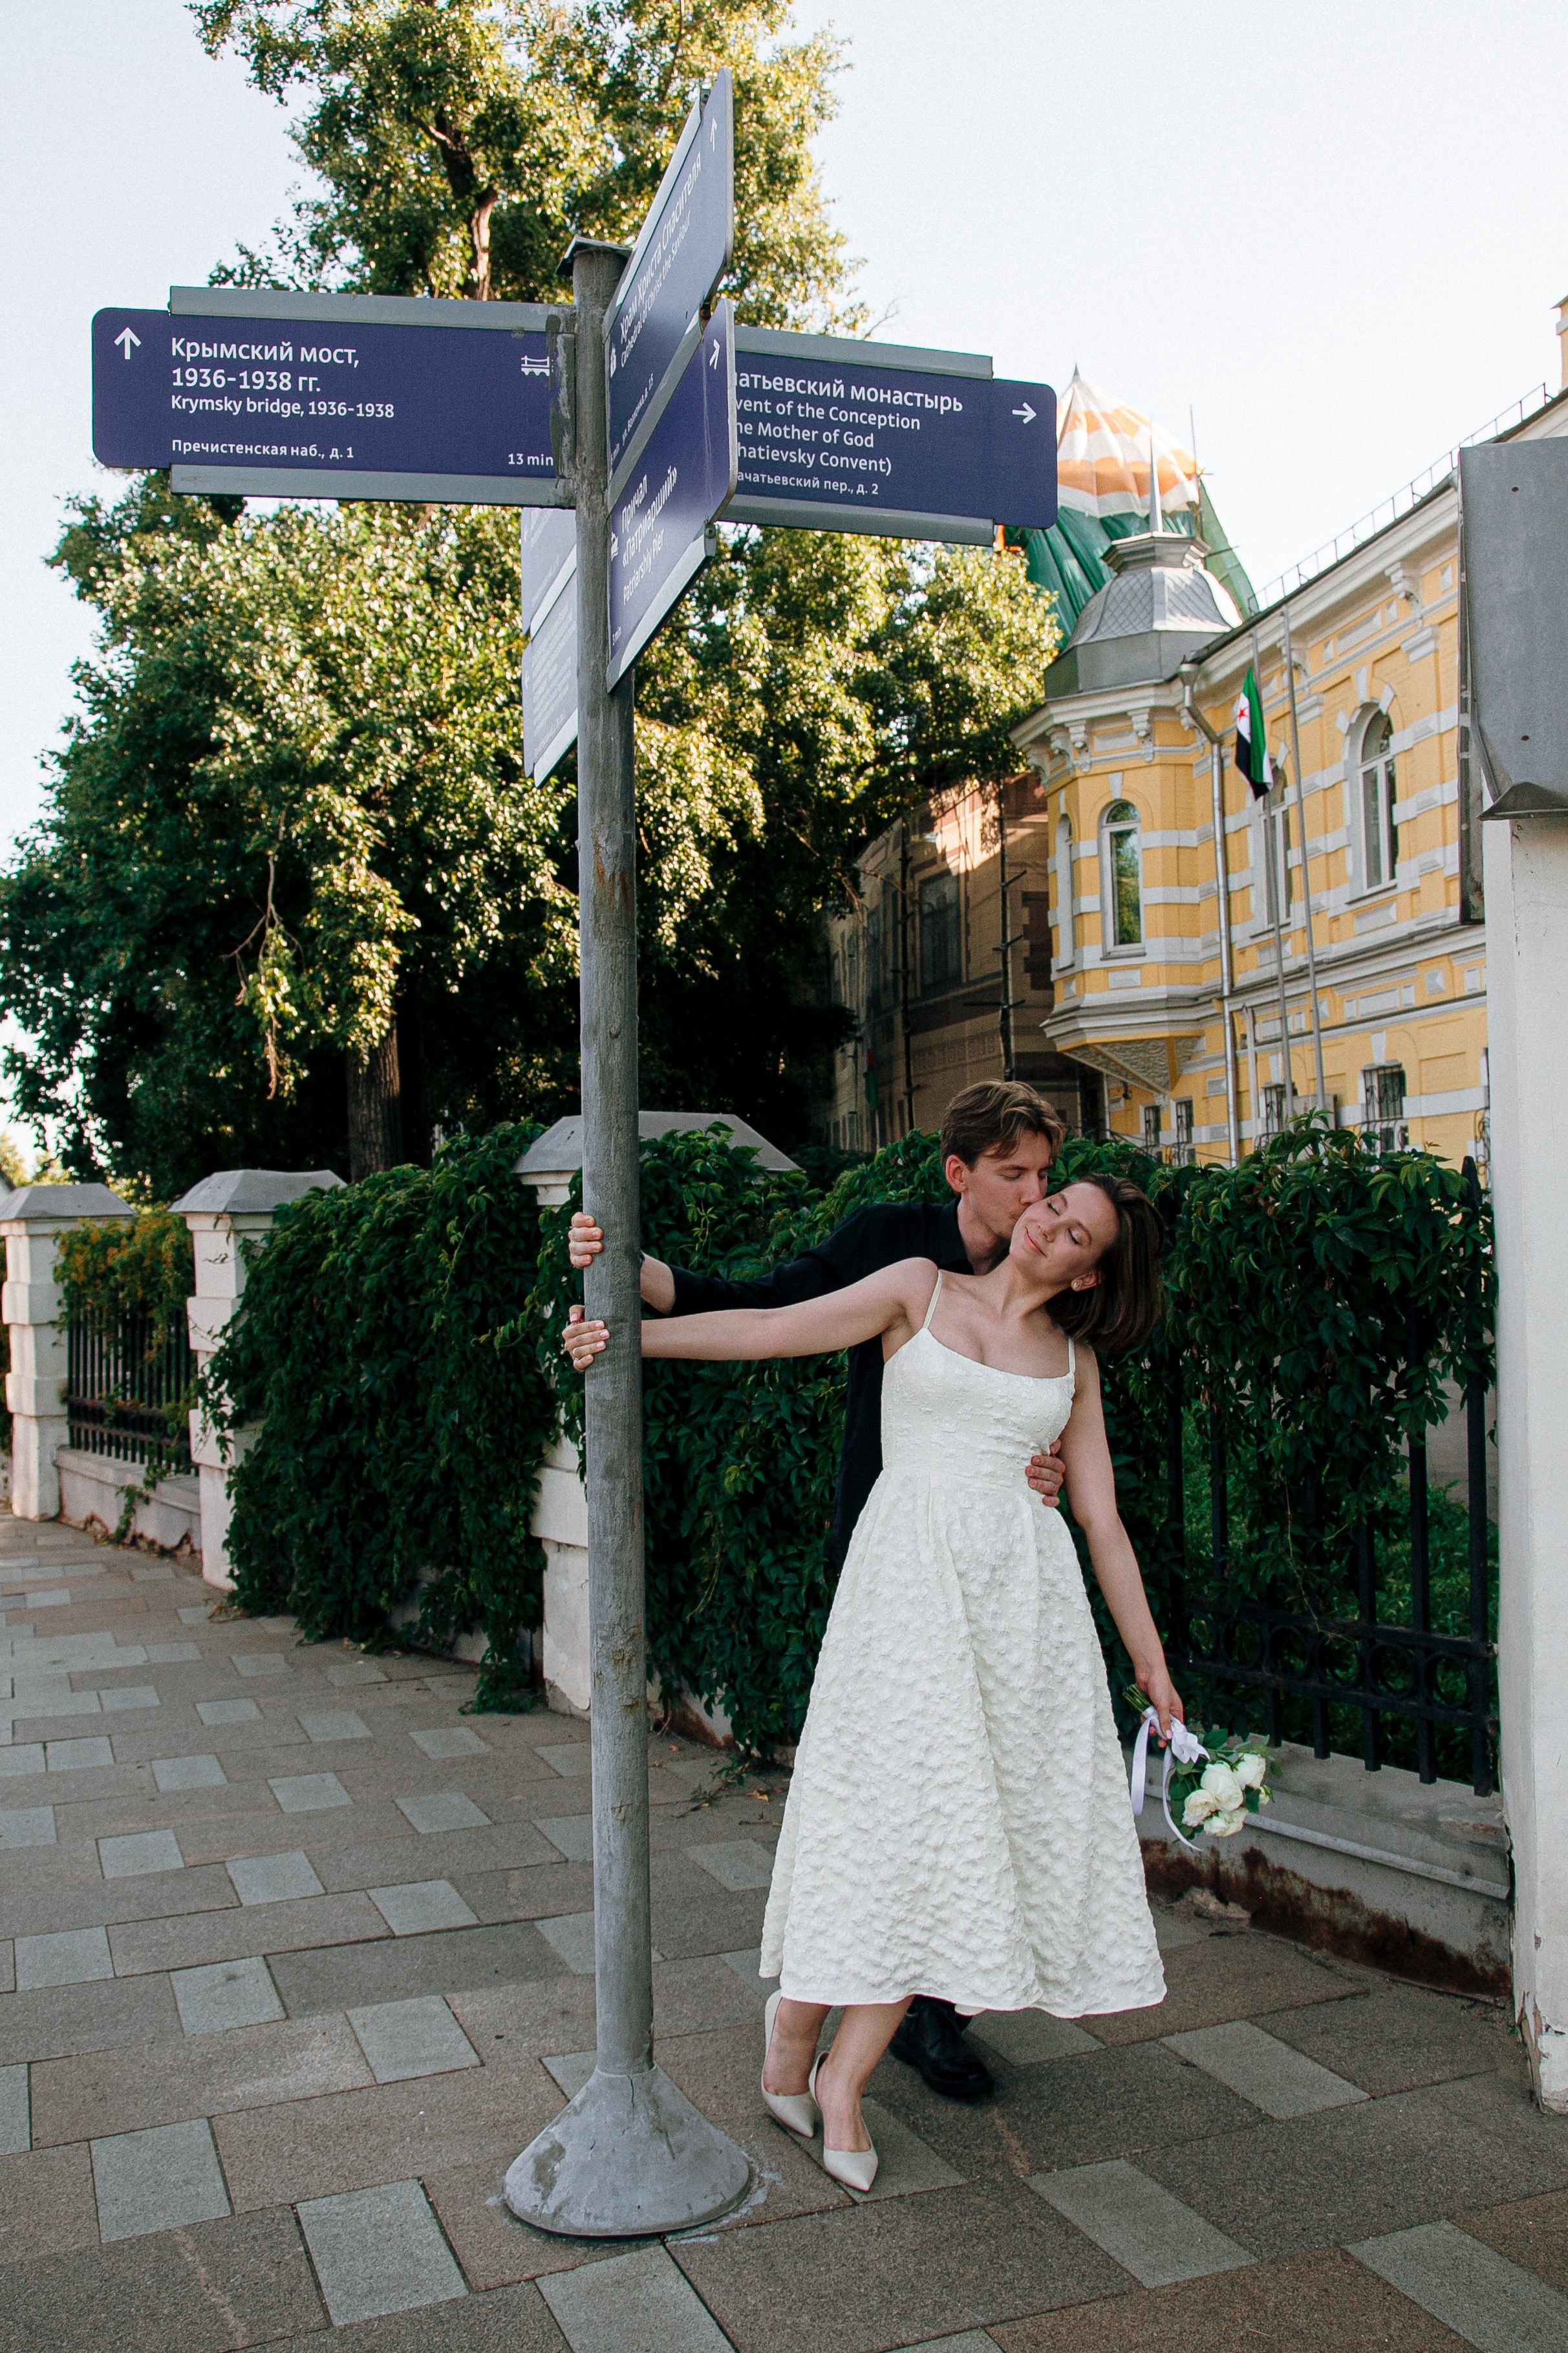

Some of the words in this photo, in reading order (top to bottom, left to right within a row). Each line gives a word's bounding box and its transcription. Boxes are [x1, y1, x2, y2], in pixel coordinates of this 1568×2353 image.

[620, 295, 638, 345] Храм
[638, 242, 662, 307] Христа
[661, 151, 702, 251] Спасителя
[621, 312, 643, 367] Cathedral
[642, 299, 648, 323] of
[647, 272, 663, 311] Christ
[663, 254, 671, 280] the
[671, 210, 691, 261] Saviour
[171, 337, 293, 362] Крымский
[301, 347, 360, 369] мост,
[172, 367, 292, 392] 1936-1938
[298, 376, 321, 393] гг.
[171, 395, 242, 416] Krymsky
[246, 396, 305, 418] bridge,
[309, 400, 394, 419] 1936-1938
[776, 400, 794, 416] of
[797, 402, 825, 420] the
[830, 406, 921, 430] Conception
[850, 385, 963, 416] монастырь
[171, 439, 287, 457] Пречистенская
[290, 444, 325, 460] наб.,
[329, 448, 343, 460] д.
[347, 446, 354, 459] 1
[758, 422, 819, 444] Mother
[822, 429, 841, 444] of
[843, 431, 874, 449] God
[508, 453, 524, 465] 13
[527, 453, 554, 466] min
[819, 451, 892, 477] Convent)
[738, 472, 821, 492] ачатьевский
[824, 480, 854, 495] пер.,
[856, 484, 868, 496] д.
[872, 483, 879, 495] 2
[622, 474, 647, 534] Причал
[622, 465, 678, 569] «Патриарший»
[623, 548, 652, 606] Patriarshiy
[652, 528, 664, 560] Pier
